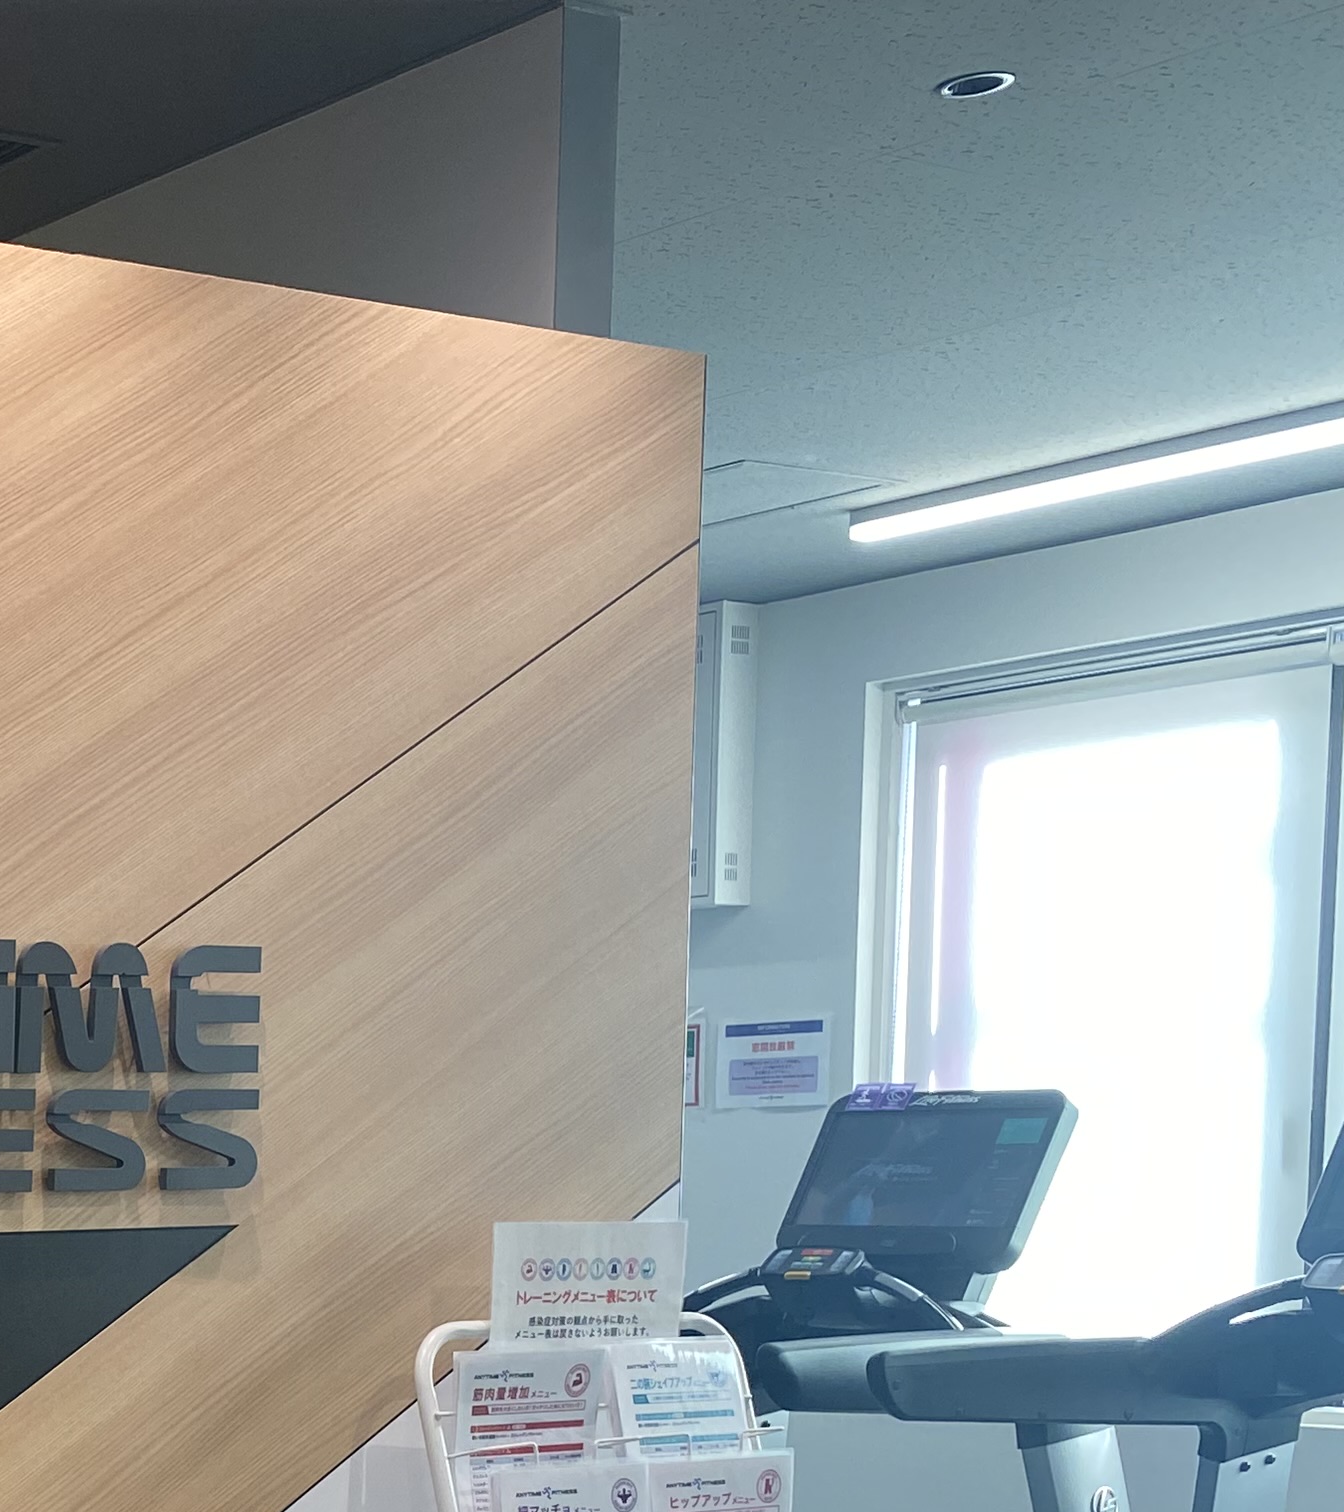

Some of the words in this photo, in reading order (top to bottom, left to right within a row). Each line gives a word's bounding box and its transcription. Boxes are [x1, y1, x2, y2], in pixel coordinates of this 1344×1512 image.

[516, 1289, 658, 1306] トレーニングメニュー表について
